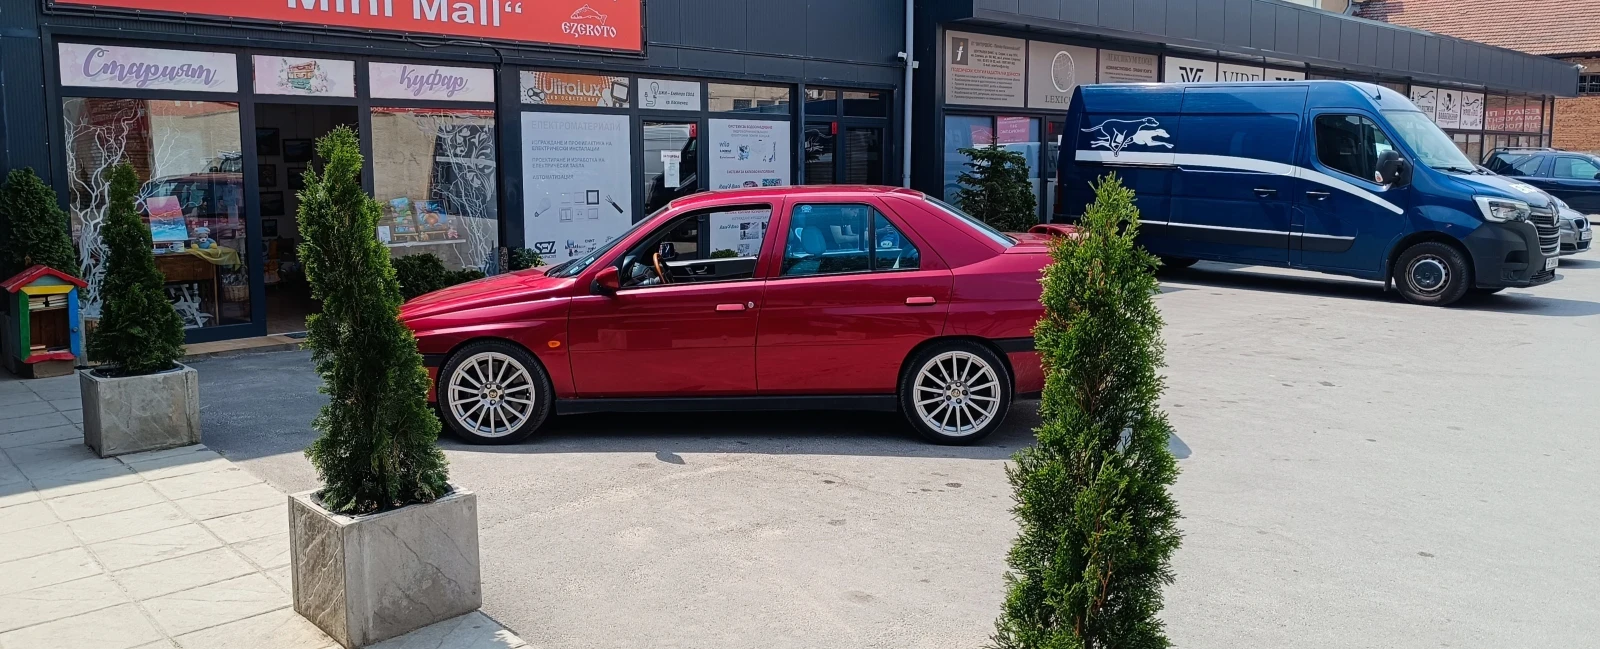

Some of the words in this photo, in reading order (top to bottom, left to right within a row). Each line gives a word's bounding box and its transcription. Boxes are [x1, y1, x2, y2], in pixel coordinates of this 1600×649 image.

[83, 47, 217, 87] Старият
[399, 65, 469, 98] Куфар
[542, 76, 602, 97] UltraLux
[534, 240, 557, 255] SEZ
